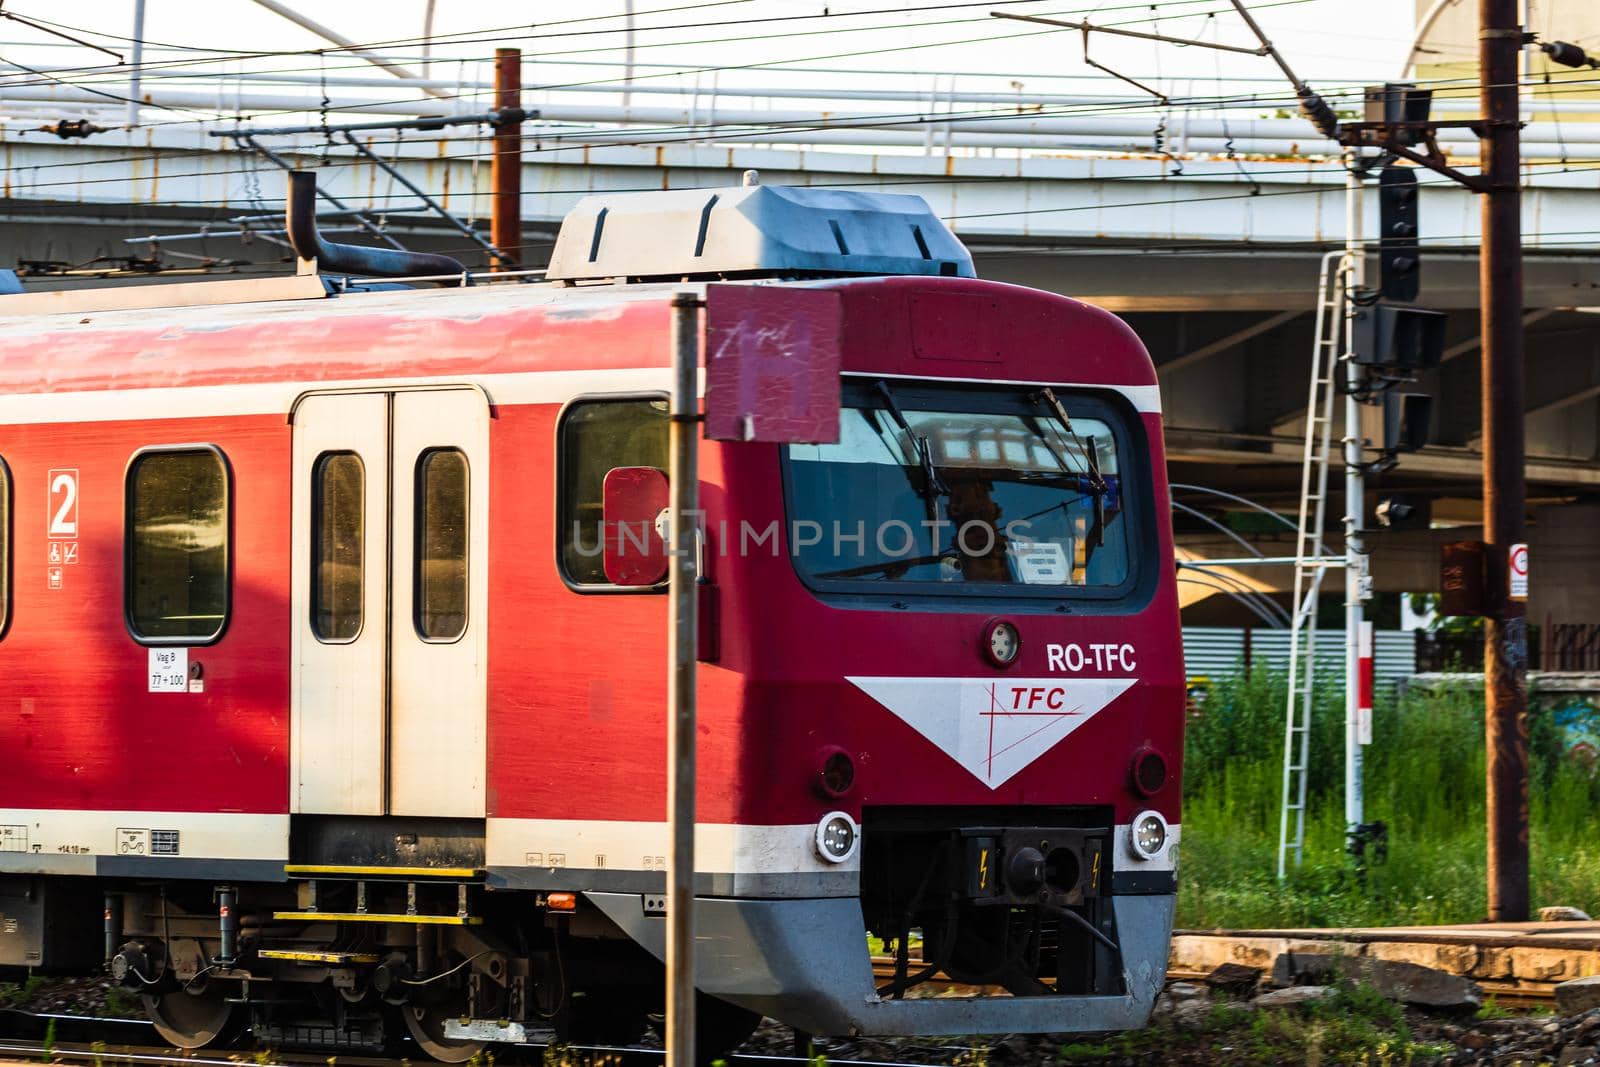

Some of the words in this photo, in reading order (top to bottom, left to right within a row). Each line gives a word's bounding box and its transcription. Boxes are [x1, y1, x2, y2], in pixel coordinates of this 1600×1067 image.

[51, 474, 76, 533] 2
[156, 652, 169, 664] Vag
[1046, 643, 1137, 672] RO-TFC
[152, 675, 161, 685] 77
[170, 675, 184, 685] 100
[1011, 687, 1065, 710] TFC
